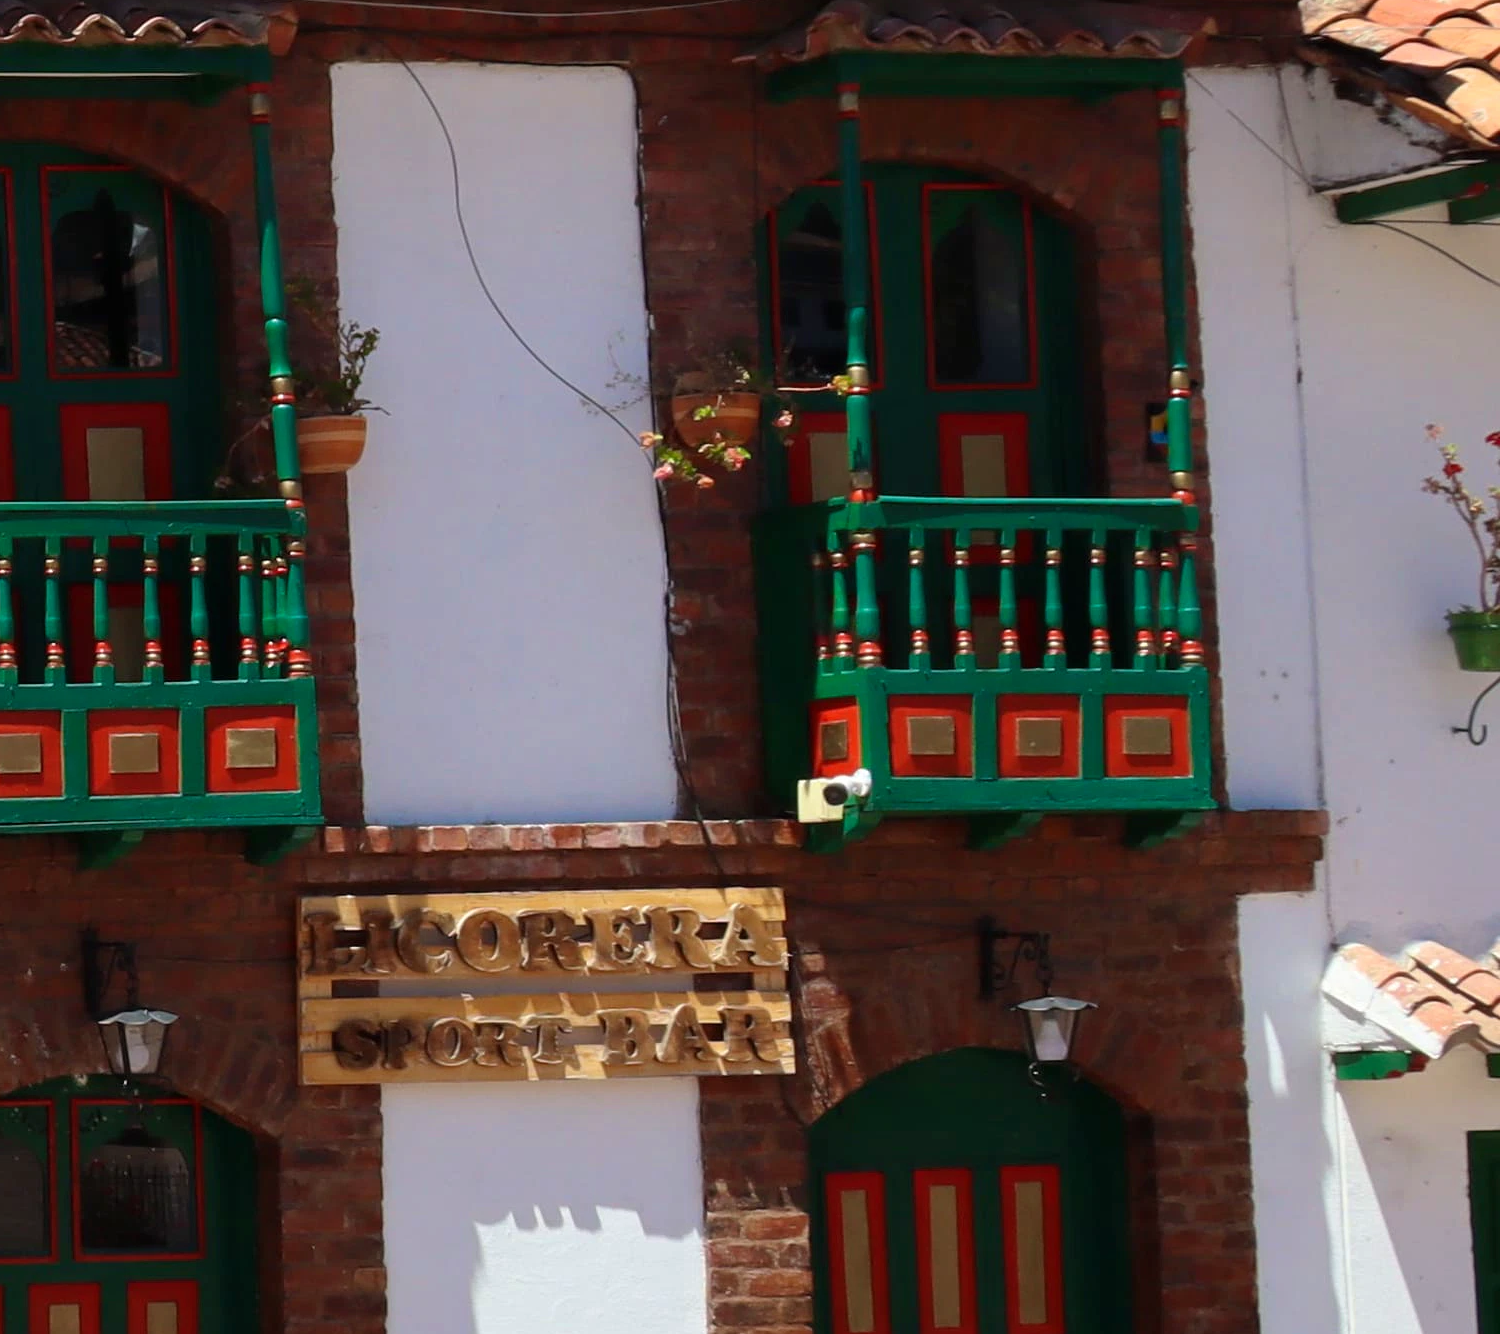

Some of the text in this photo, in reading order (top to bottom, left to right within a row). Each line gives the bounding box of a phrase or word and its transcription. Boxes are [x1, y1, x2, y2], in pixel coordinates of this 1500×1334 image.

[303, 902, 788, 973] LICORERA
[335, 1004, 781, 1070] SPORT BAR
